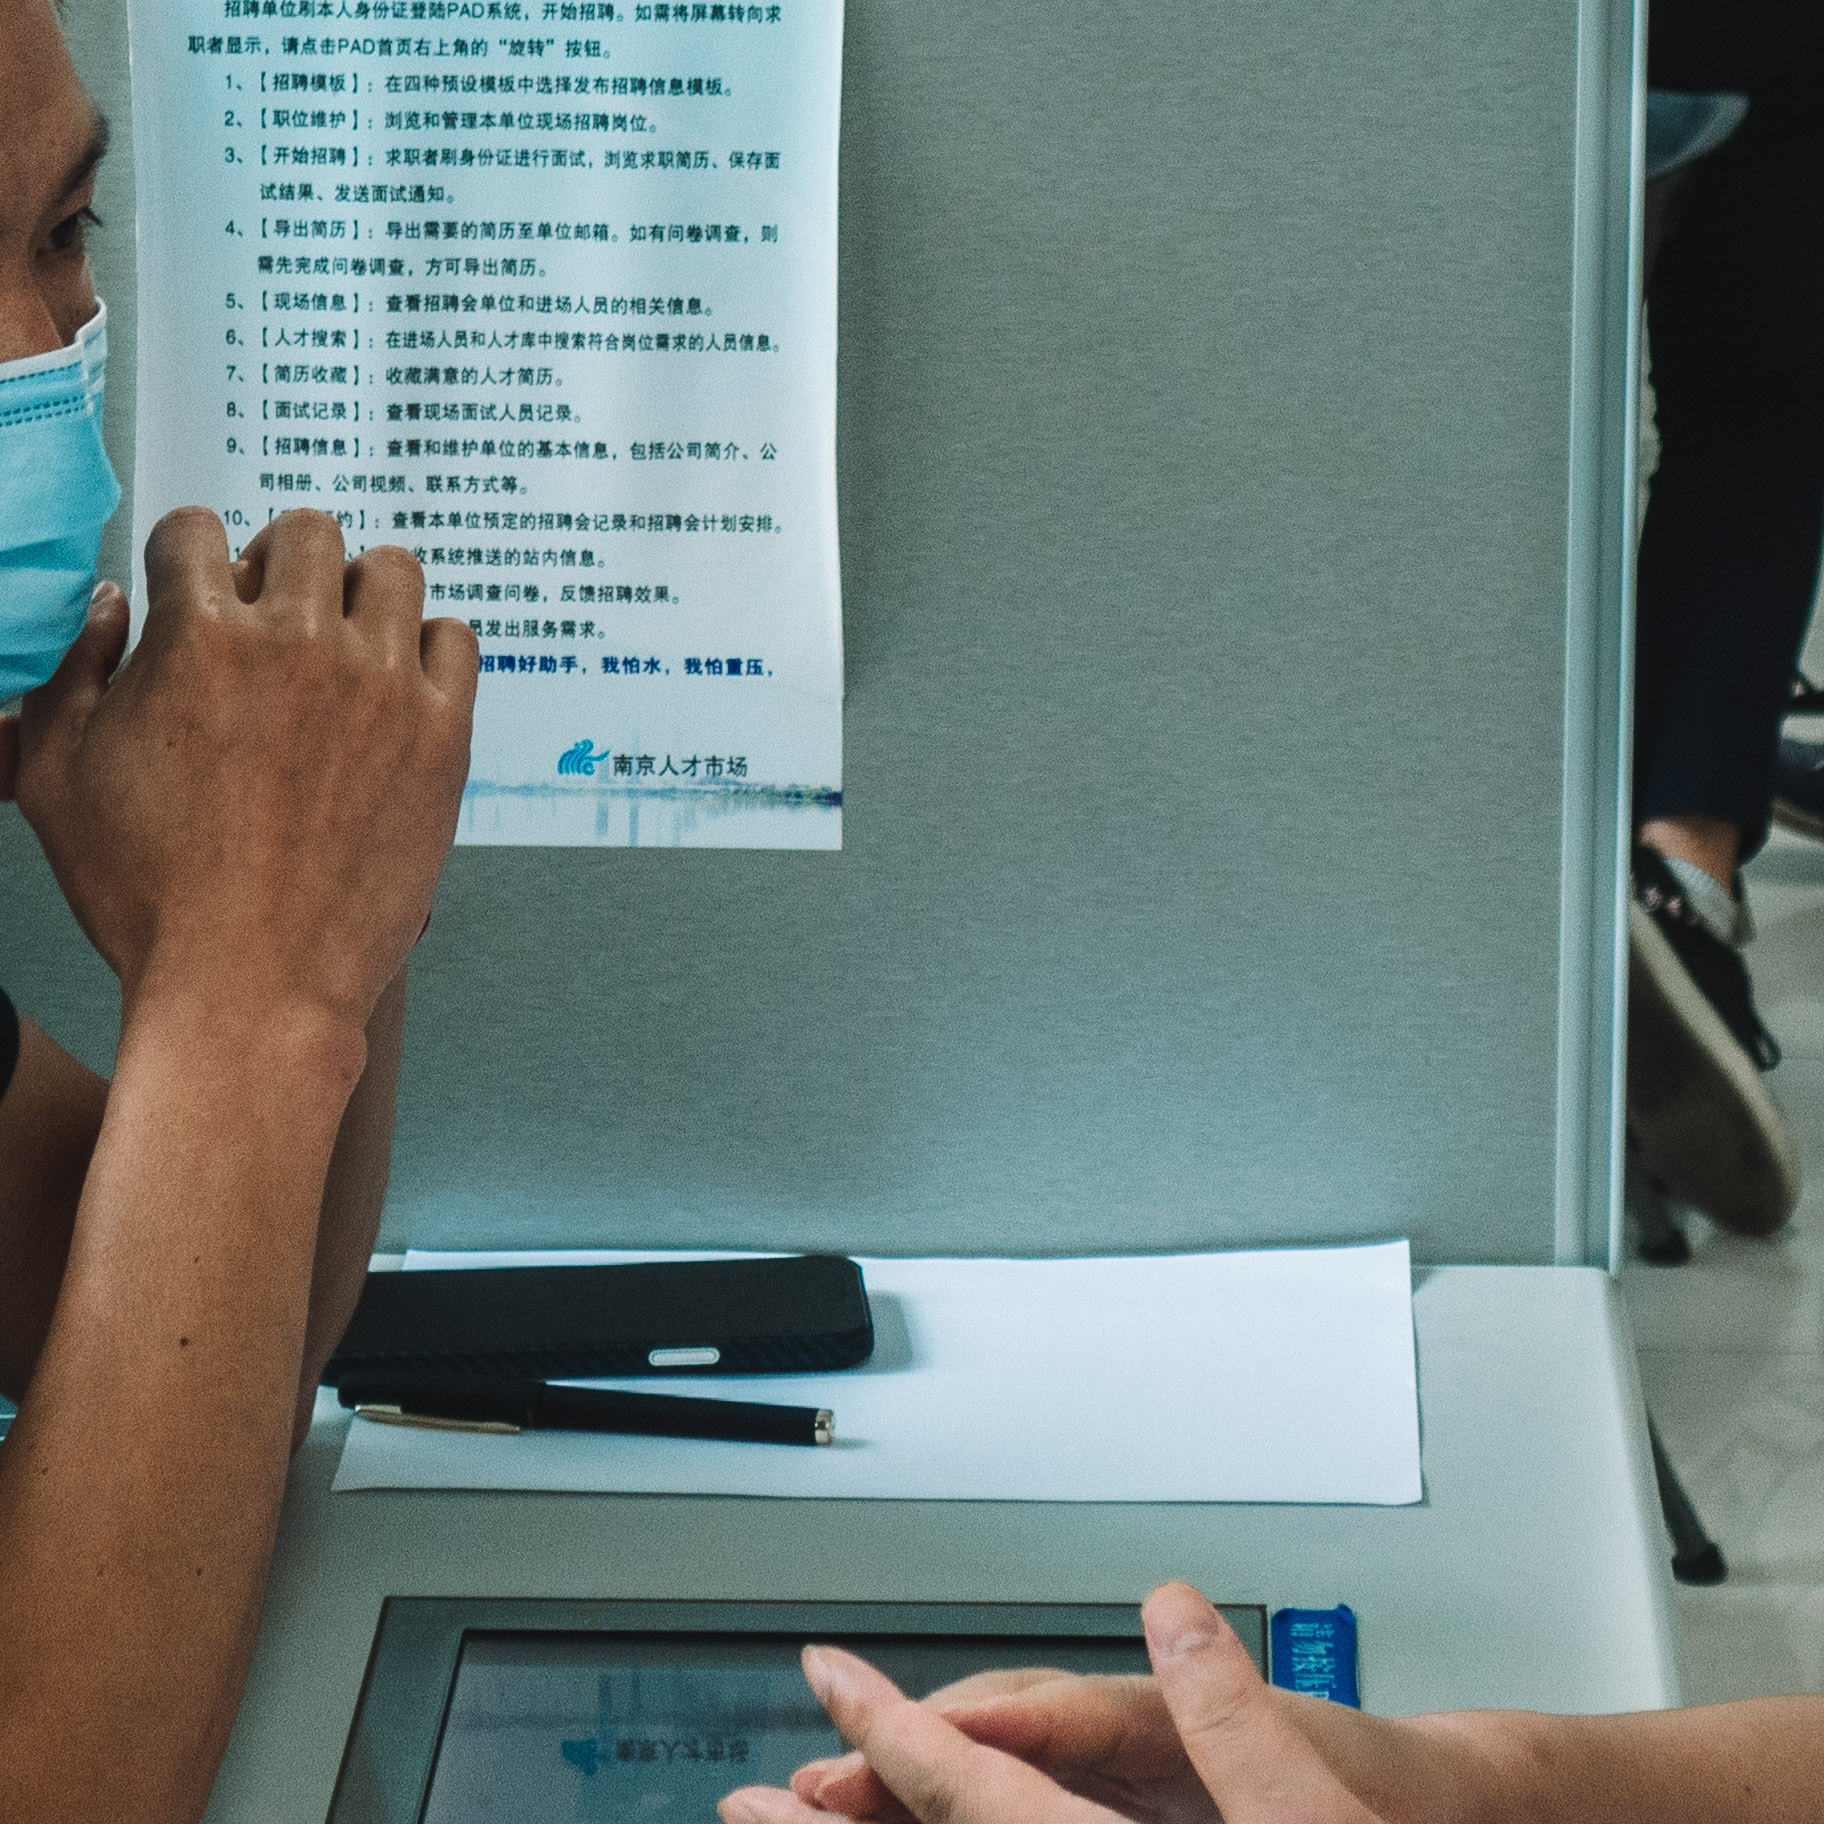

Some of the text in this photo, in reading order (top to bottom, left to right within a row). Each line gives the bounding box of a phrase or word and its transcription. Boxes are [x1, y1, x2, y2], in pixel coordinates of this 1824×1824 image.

[259, 182, 454, 204] 试结果、发送面试通知。
[257, 254, 546, 277] 需先完成问卷调查，方可导出简历。
[259, 472, 527, 495] 司相册、公司视频、联系方式等。
[422, 582, 679, 604] 市场调查问卷，反馈招聘效果。
[612, 753, 748, 780] 南京人才市场
